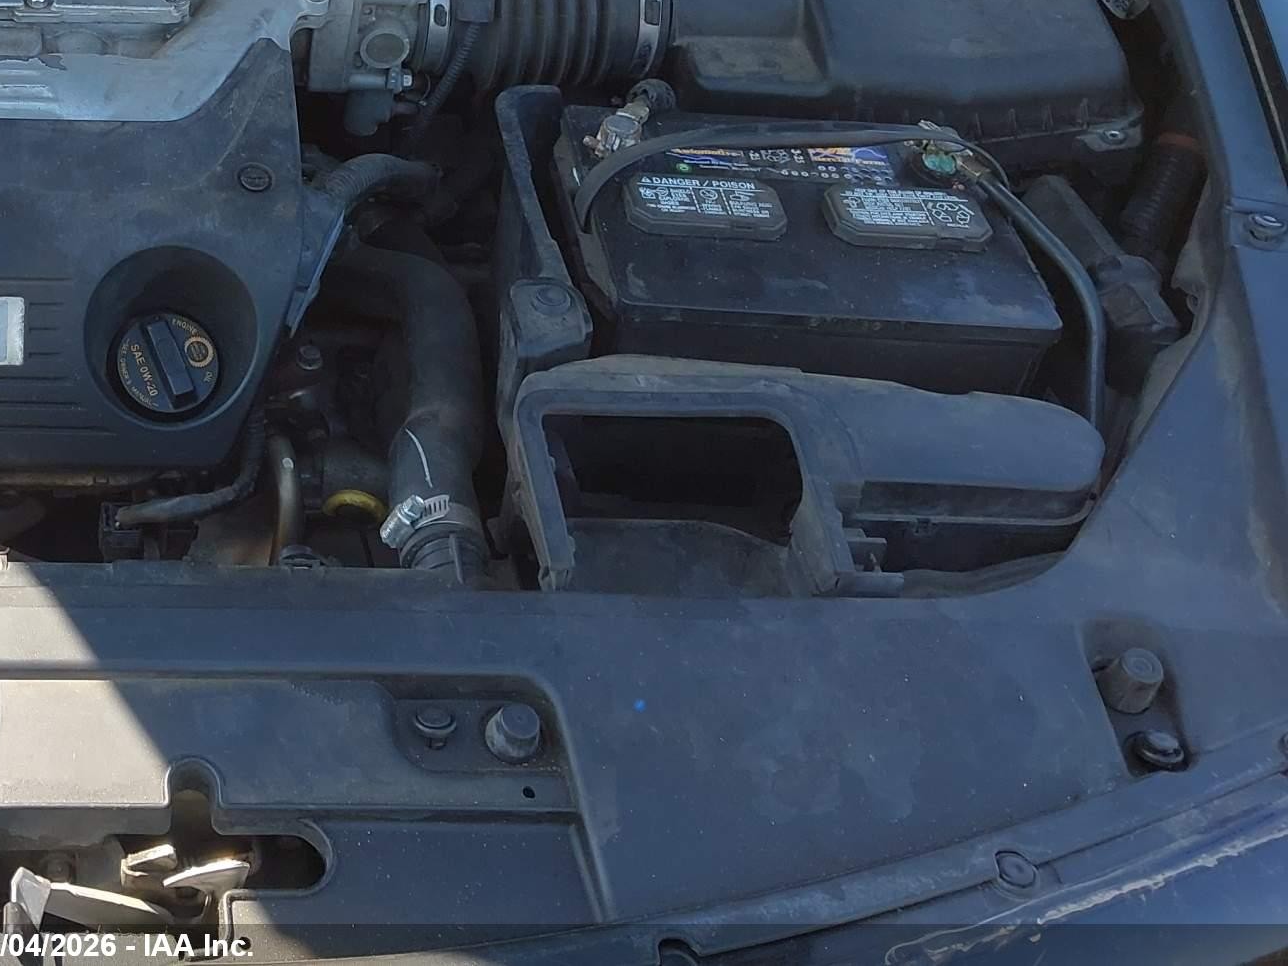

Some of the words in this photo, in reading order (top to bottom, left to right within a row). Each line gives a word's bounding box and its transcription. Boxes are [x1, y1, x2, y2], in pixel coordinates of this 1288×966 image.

[651, 176, 701, 187] DANGER
[711, 180, 756, 190] POISON
[172, 318, 198, 335] ENGINE
[130, 343, 146, 365] SAE
[140, 366, 158, 397] 0W-20
